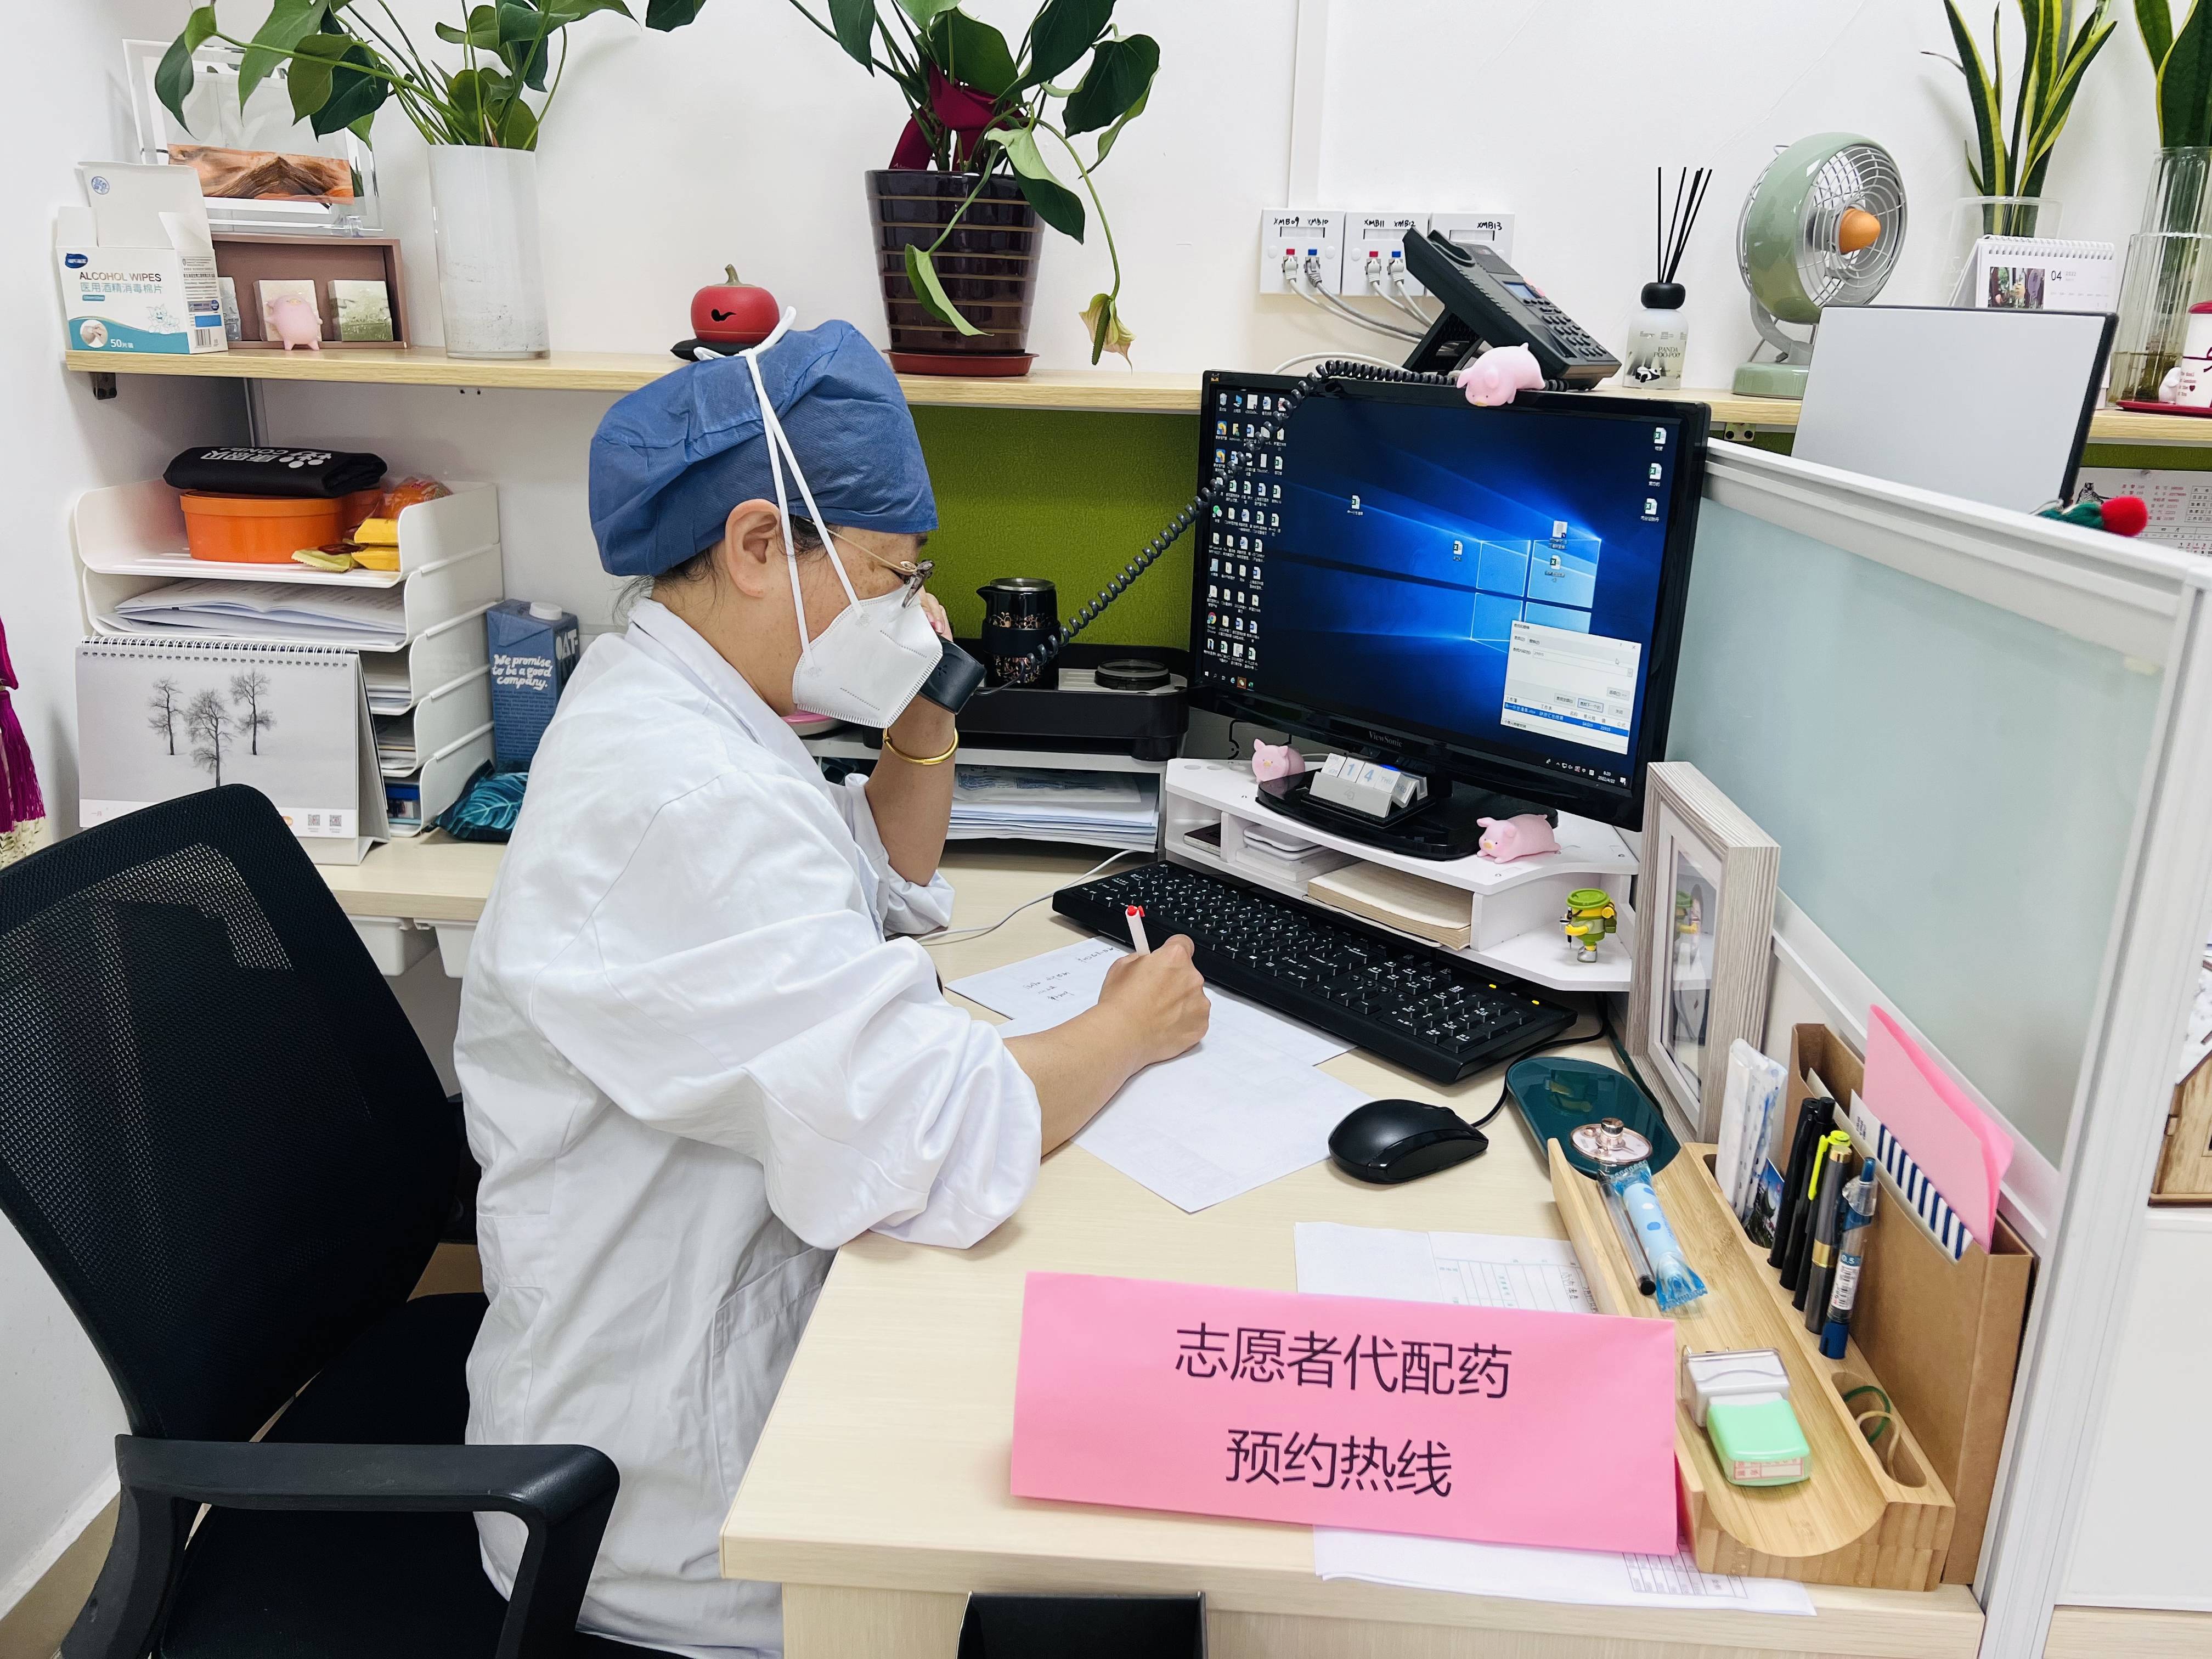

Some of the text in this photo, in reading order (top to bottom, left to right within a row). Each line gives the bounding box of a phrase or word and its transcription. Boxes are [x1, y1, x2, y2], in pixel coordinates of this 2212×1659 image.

[1273, 216, 1300, 227] XMB09
[1307, 217, 1329, 225] XMB10
[1364, 219, 1385, 227] XMB11
[1477, 222, 1503, 230] XMB13
[80, 272, 162, 282] ALCOHOL WIPES
[2051, 270, 2062, 281] 04
[80, 282, 163, 294] 医用酒精消毒棉片
[494, 654, 551, 668] We promise
[492, 664, 504, 675] to
[506, 664, 517, 675] be
[527, 665, 553, 678] good
[1369, 731, 1403, 747] ViewSonic
[1175, 1321, 1514, 1399] 志愿者代配药
[1224, 1427, 1454, 1498] 预约热线
